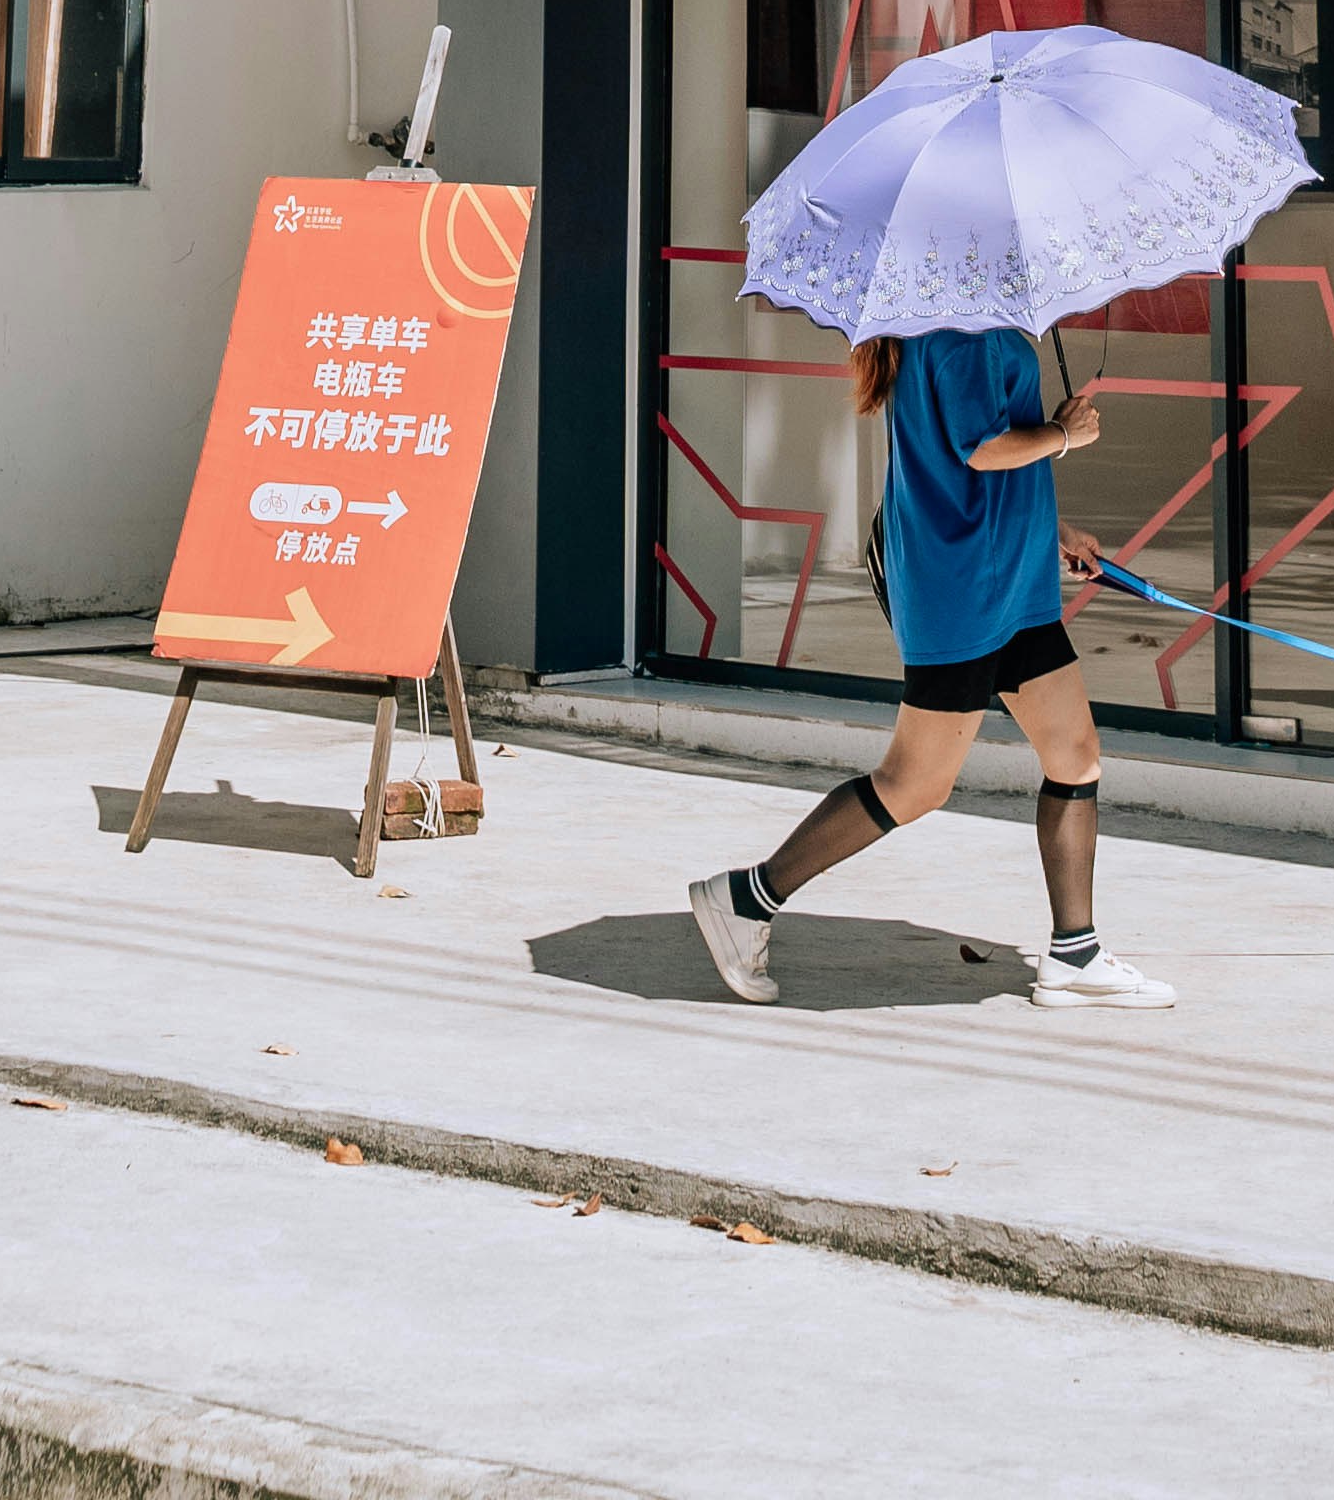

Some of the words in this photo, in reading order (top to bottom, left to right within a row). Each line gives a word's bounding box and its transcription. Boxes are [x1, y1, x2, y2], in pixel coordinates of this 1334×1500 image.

[305, 312, 431, 354] 共享单车
[313, 358, 406, 400] 电瓶车
[244, 406, 452, 457] 不可停放于此
[275, 529, 361, 566] 停放点
